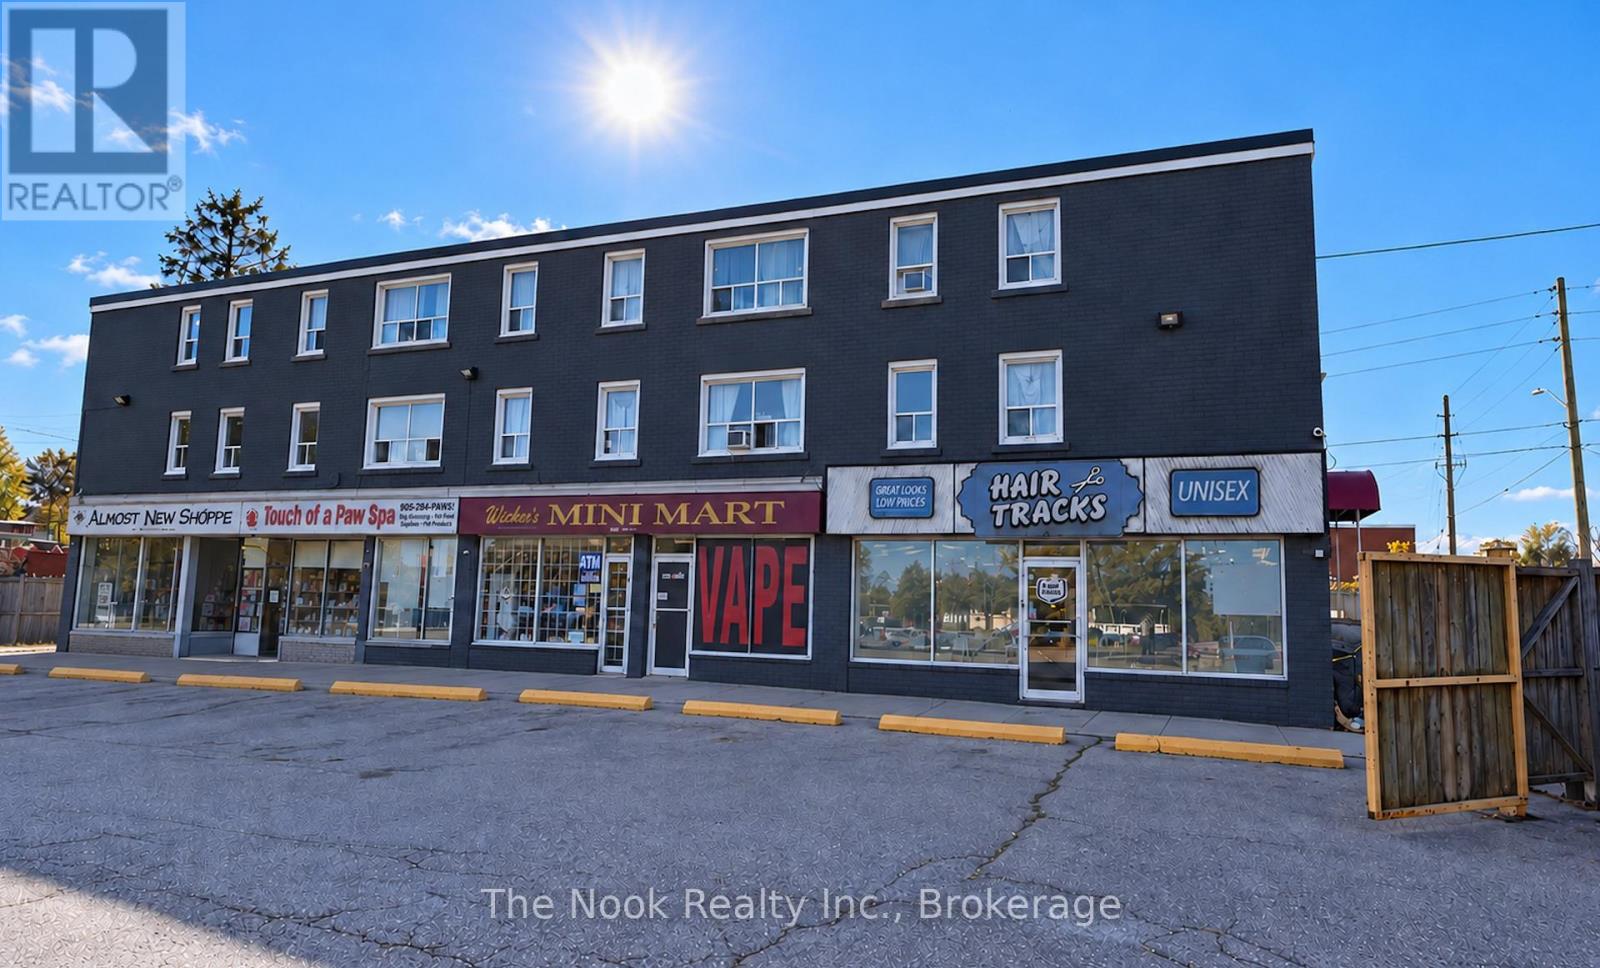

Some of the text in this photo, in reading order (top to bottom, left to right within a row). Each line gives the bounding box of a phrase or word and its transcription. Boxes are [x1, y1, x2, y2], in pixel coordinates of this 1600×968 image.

[875, 485, 899, 496] GREAT
[990, 469, 1060, 500] HAIR
[1178, 479, 1251, 502] UNISEX
[486, 501, 785, 526] Wicker's MINI MART
[876, 497, 926, 508] LOW PRICES
[991, 494, 1107, 527] TRACKS
[144, 510, 176, 526] NEW
[264, 503, 397, 531] Touch of a Paw Spa
[580, 554, 601, 570] ATM
[698, 545, 808, 647] VAPE
